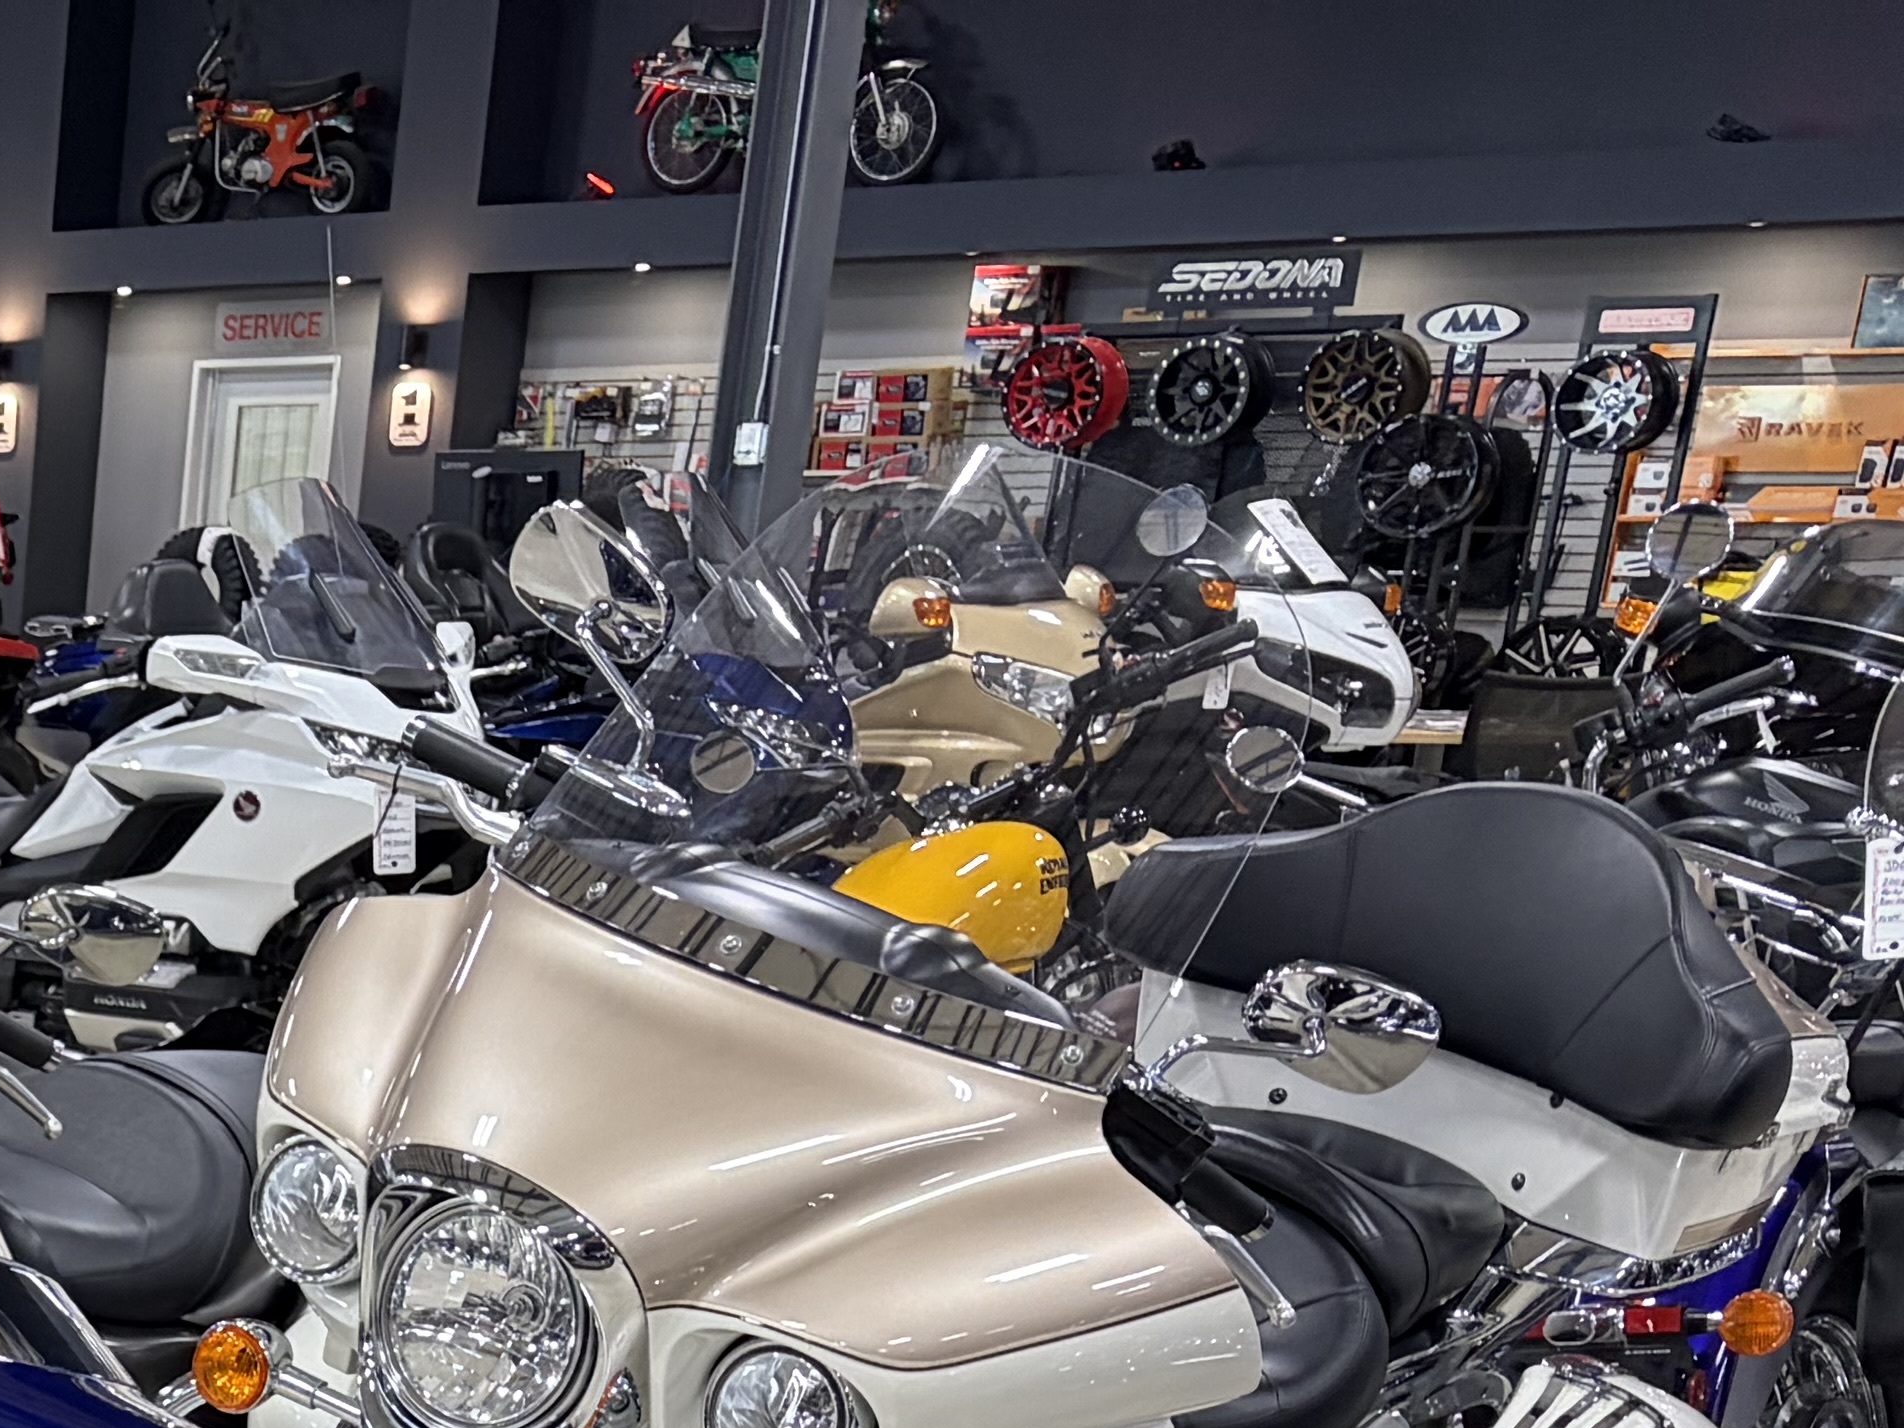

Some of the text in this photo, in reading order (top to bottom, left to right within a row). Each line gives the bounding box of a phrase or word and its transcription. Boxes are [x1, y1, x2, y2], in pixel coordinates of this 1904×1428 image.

[1158, 257, 1345, 293] SEDONA
[222, 310, 324, 343] SERVICE
[1765, 421, 1864, 438] RAVEK
[1743, 796, 1803, 825] HONDA
